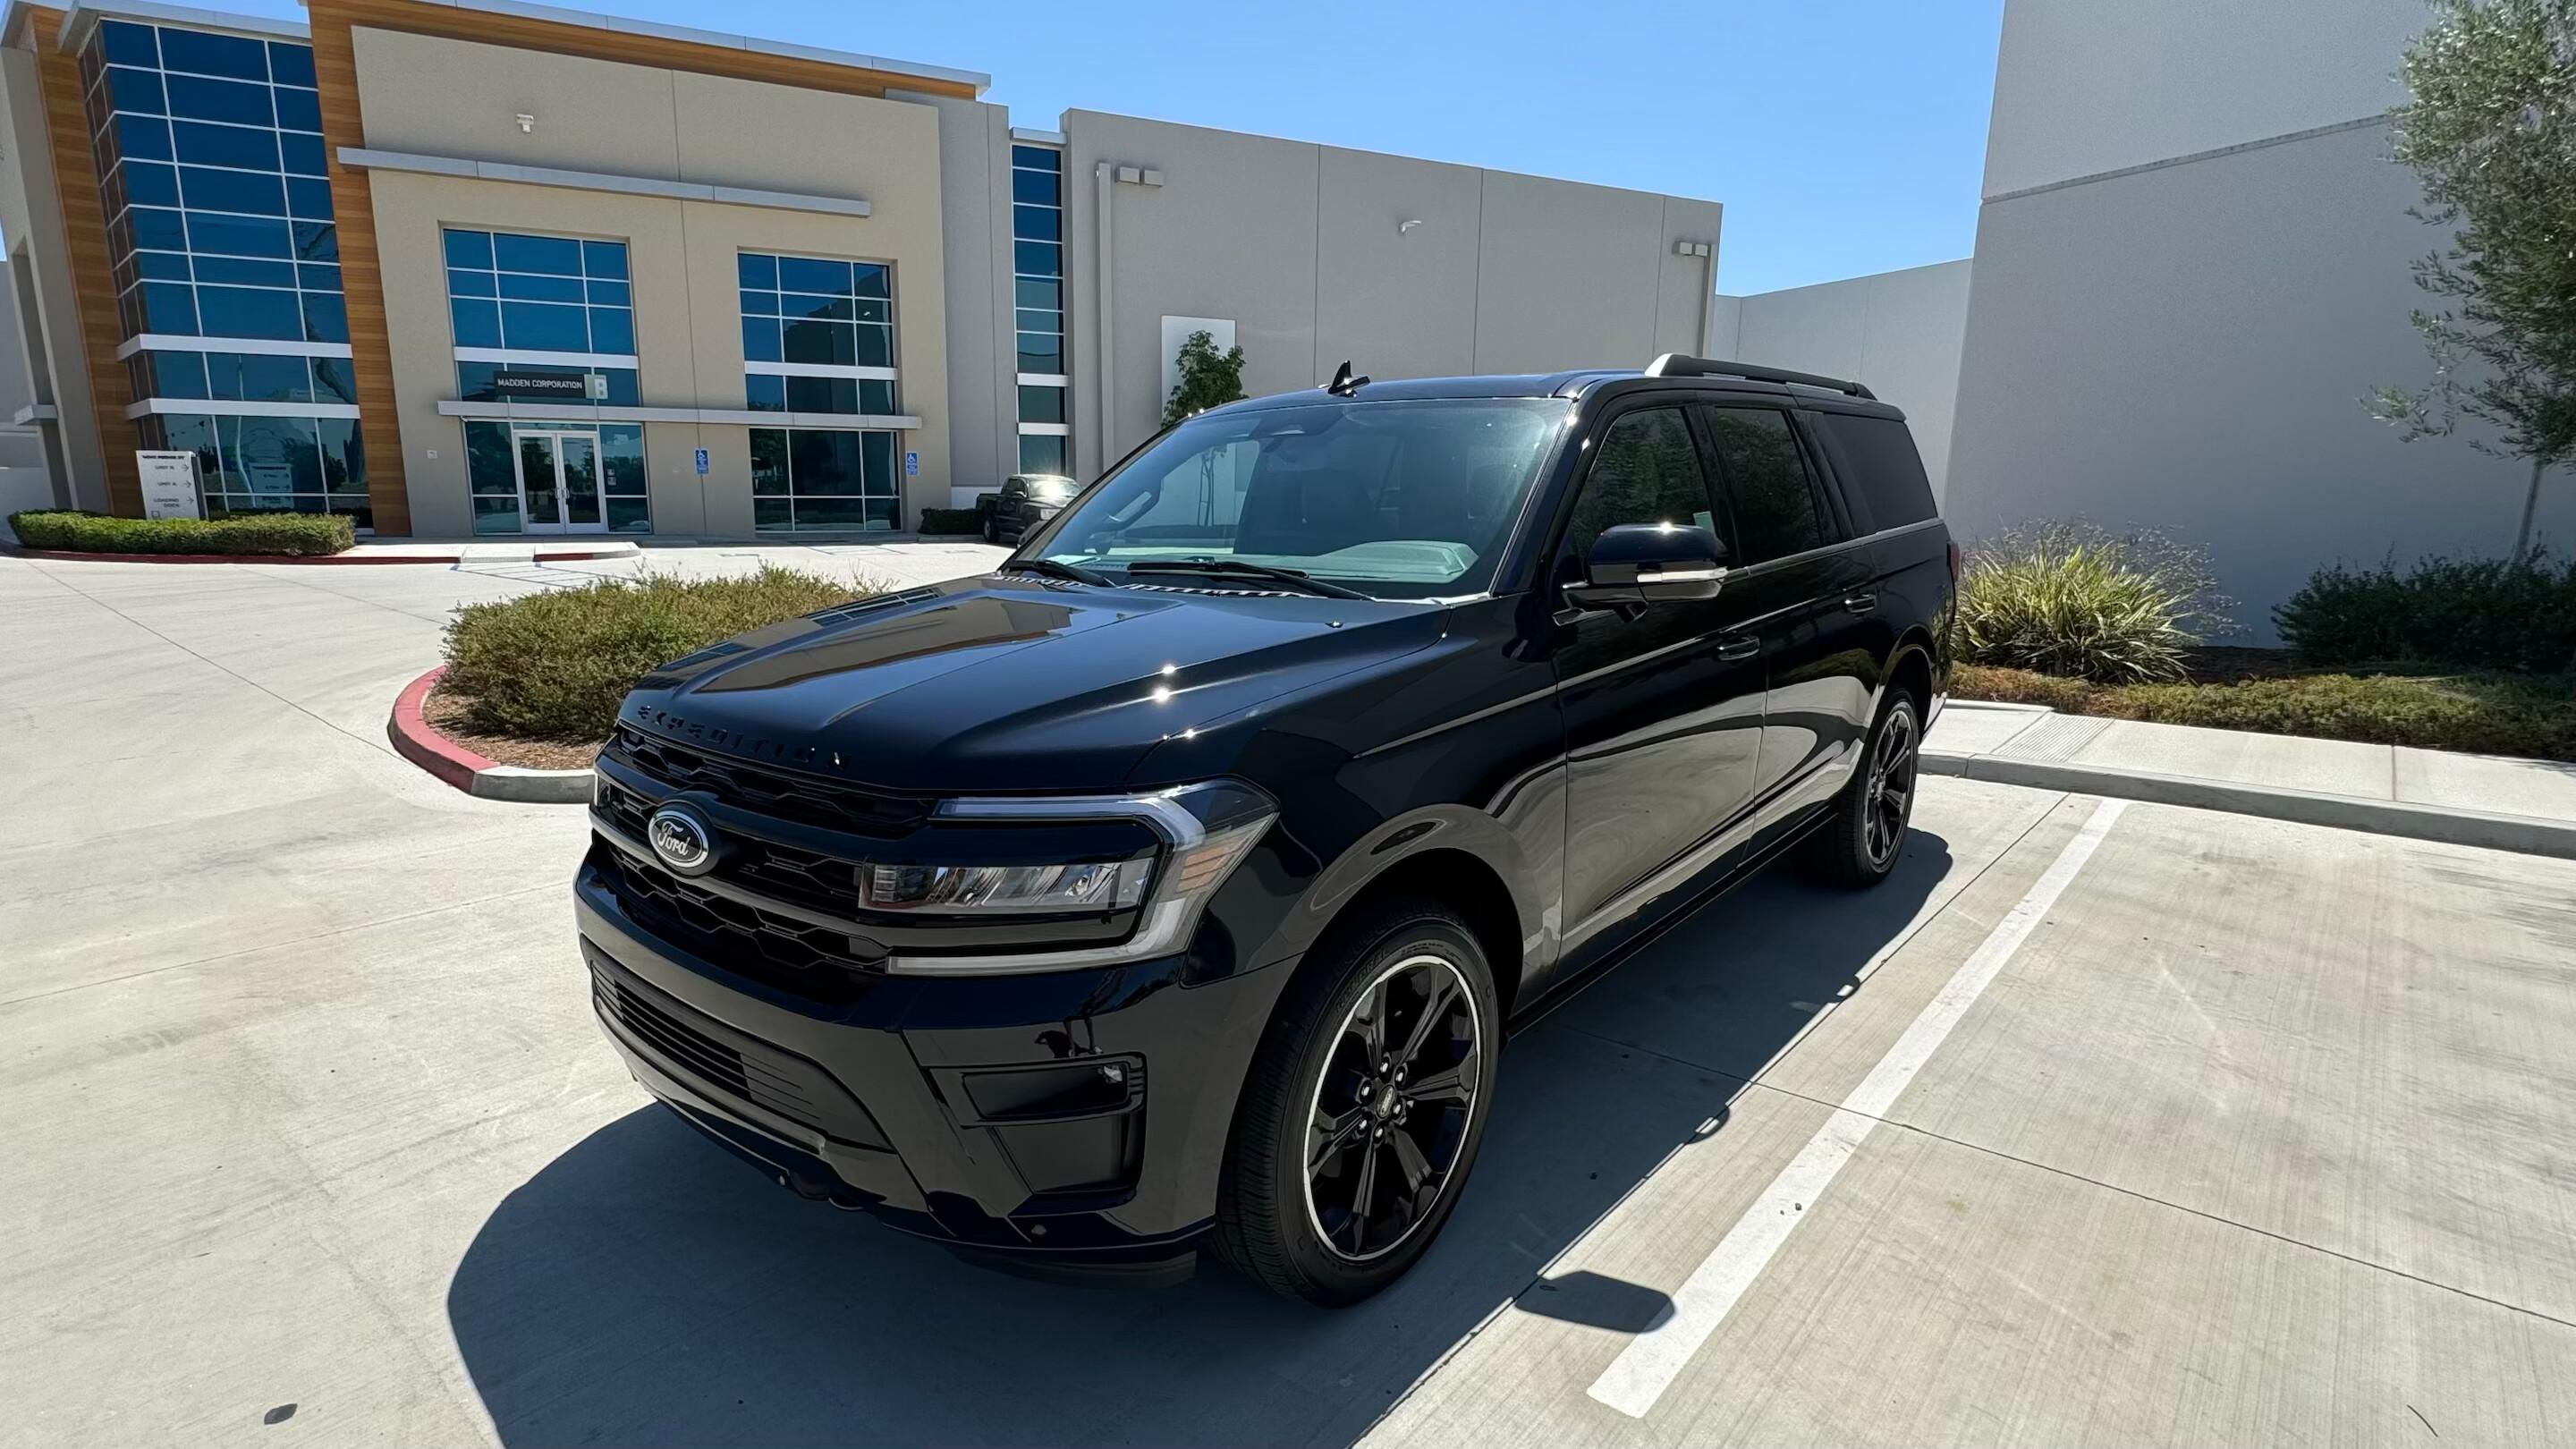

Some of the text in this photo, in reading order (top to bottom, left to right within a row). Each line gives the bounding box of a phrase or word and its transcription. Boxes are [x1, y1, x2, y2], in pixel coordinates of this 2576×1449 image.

[497, 378, 582, 389] MADDEN CORPORATION
[657, 820, 689, 856] Ford
